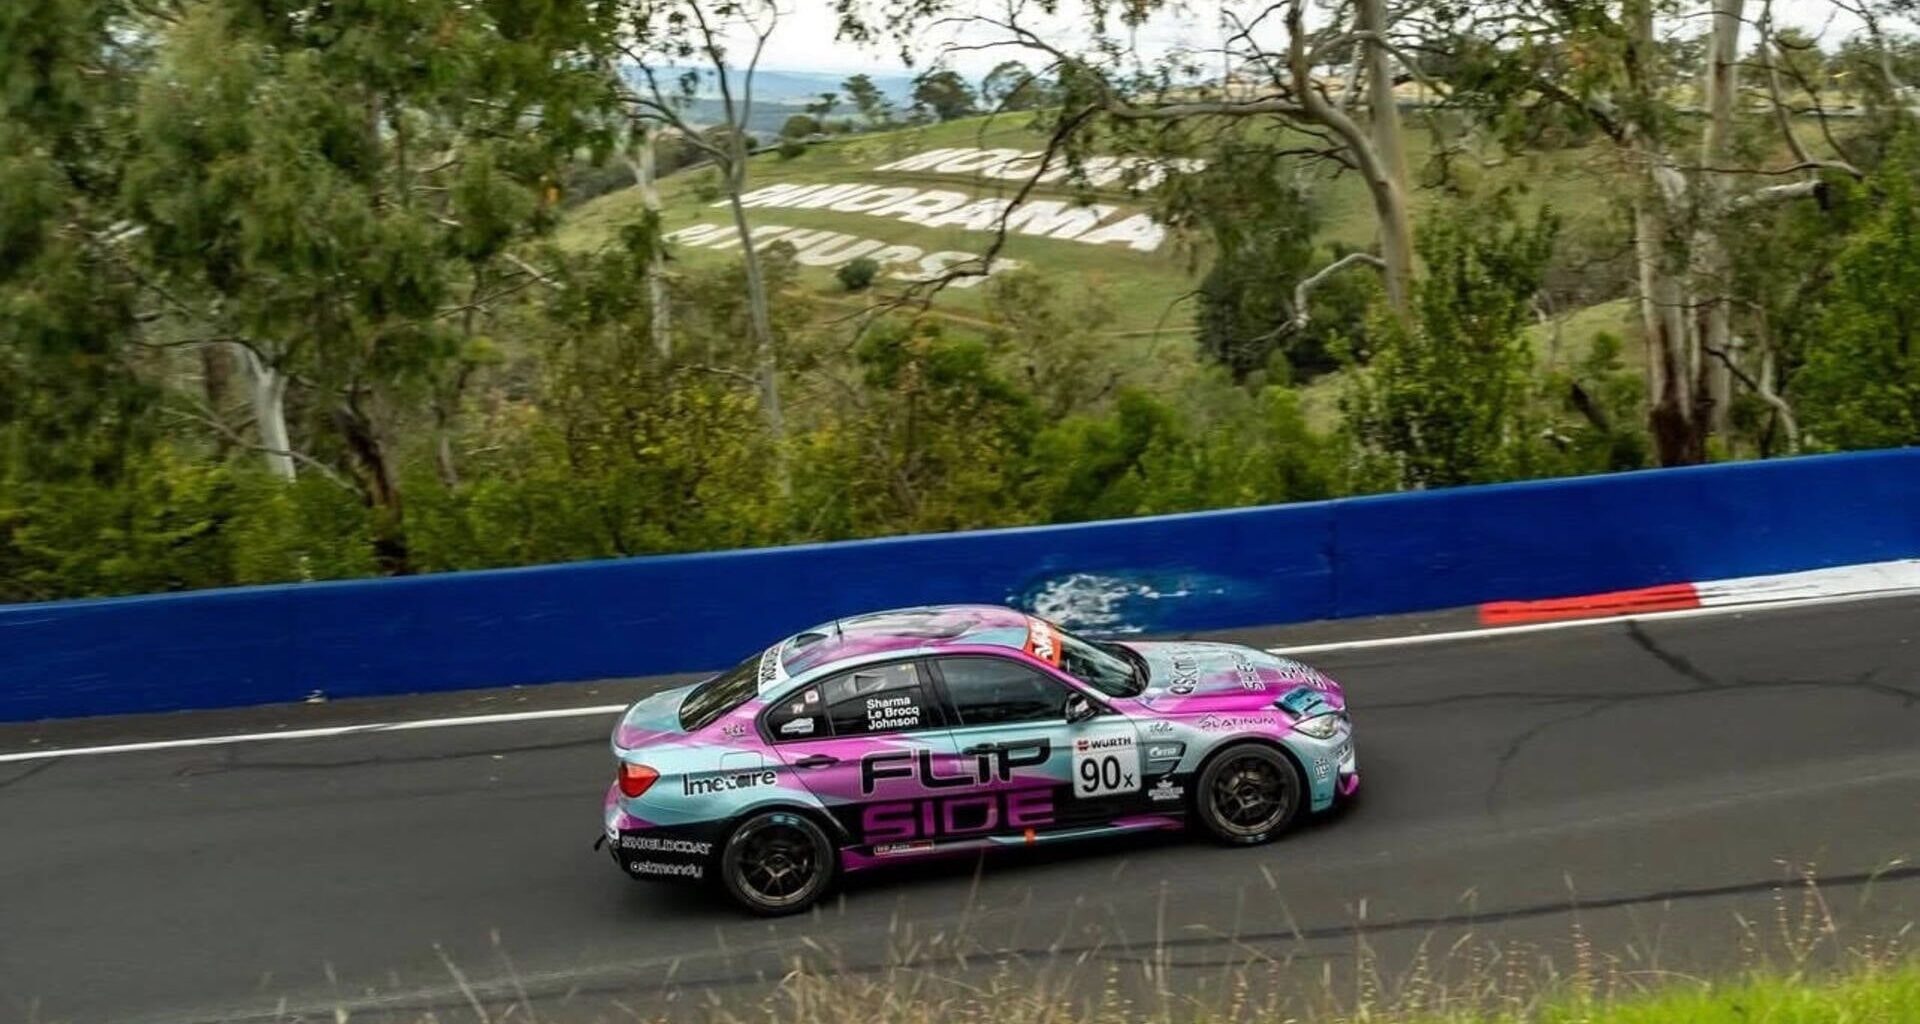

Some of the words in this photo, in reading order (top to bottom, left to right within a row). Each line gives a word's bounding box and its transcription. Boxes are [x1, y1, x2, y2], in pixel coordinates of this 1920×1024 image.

[866, 696, 911, 709] Sharma
[867, 709, 882, 720] Le
[884, 706, 920, 718] Brocq
[868, 716, 919, 730] Johnson
[859, 737, 1052, 795] FLIP
[862, 789, 1055, 845] SIDE
